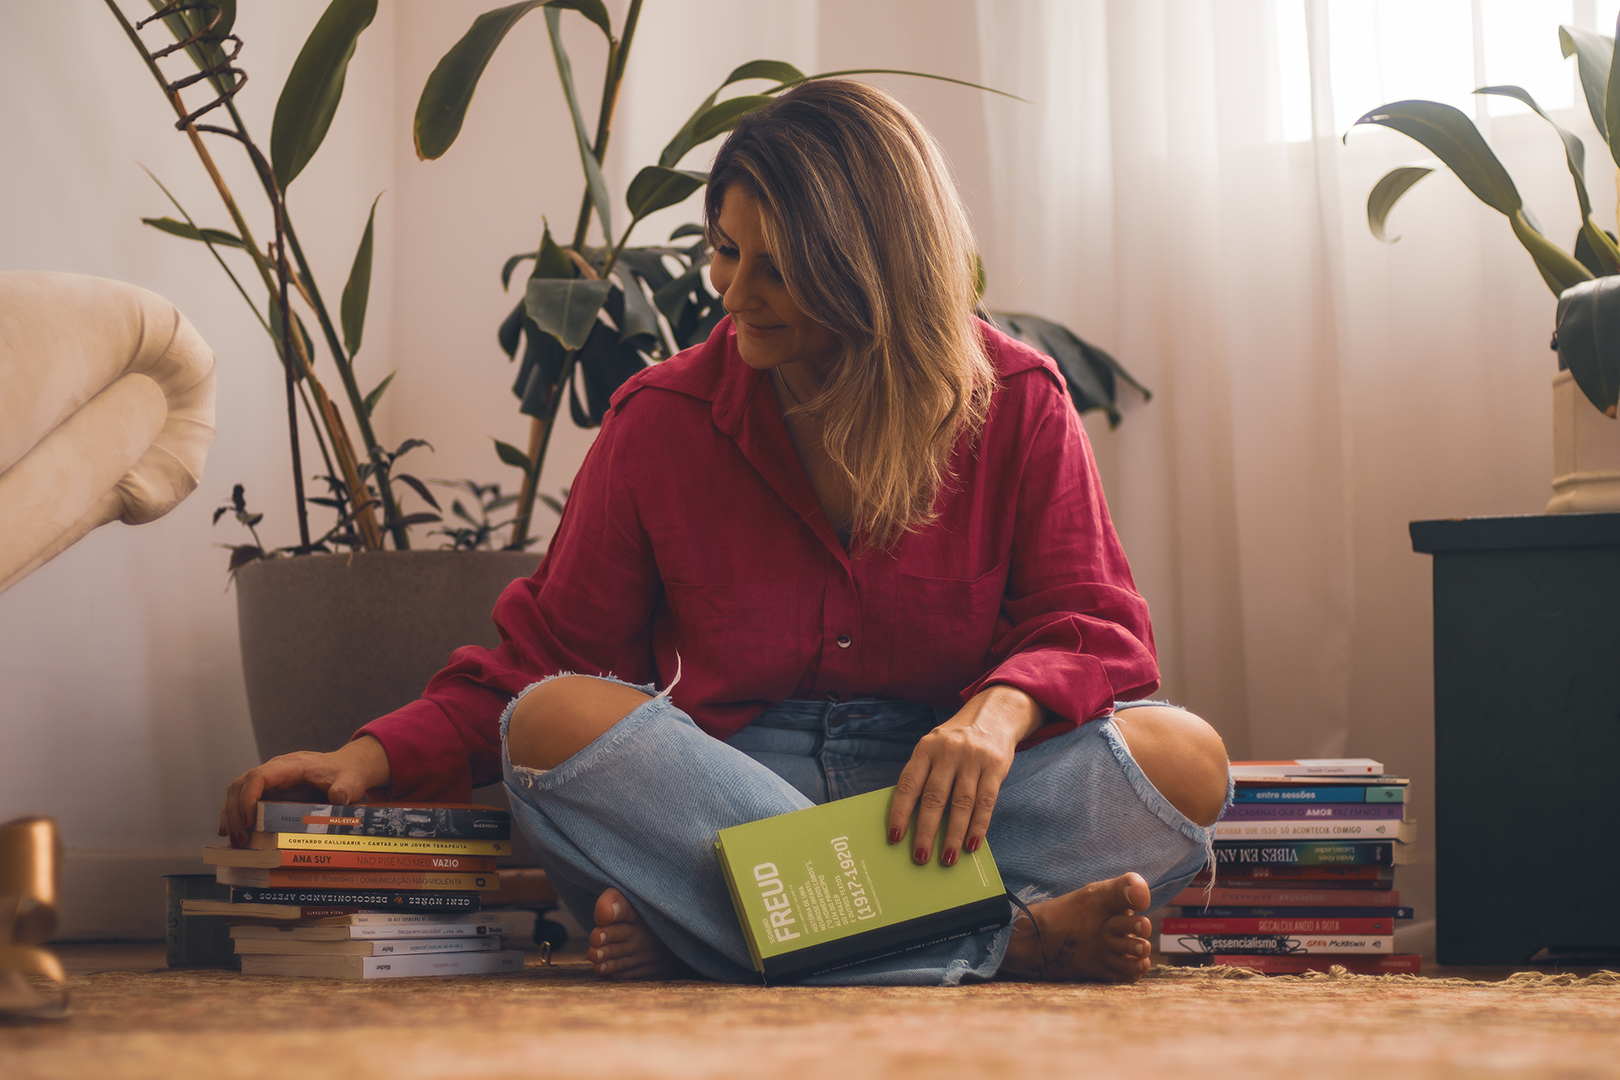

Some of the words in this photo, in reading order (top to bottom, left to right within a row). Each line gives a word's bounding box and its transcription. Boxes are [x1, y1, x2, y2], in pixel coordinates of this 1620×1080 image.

[1282, 790, 1316, 799] sessões
[1306, 808, 1333, 816] AMOR
[1334, 808, 1348, 816] FAZ
[1350, 808, 1362, 816] EM
[1363, 807, 1382, 816] NÓS
[1244, 827, 1258, 835] QUE
[1280, 824, 1290, 834] SÓ
[1292, 826, 1330, 834] ACONTECIA
[1332, 826, 1362, 834] COMIGO
[292, 854, 312, 864] ANA
[314, 855, 332, 864] SUY
[356, 854, 376, 866] NÃO
[379, 857, 395, 866] PISE
[396, 857, 411, 866] NO
[412, 858, 431, 867] MEU
[432, 858, 459, 868] VAZIO
[1240, 848, 1259, 862] EM
[1261, 848, 1298, 862] VIBES
[830, 835, 876, 920] (1917-1920)
[1254, 868, 1270, 877] POR
[288, 874, 313, 882] Marshall
[322, 875, 354, 884] Rosenberg
[360, 876, 412, 886] COMUNICAÇÃO
[413, 877, 463, 886] NÃO-VIOLENTA
[834, 874, 846, 895] TEXTOS
[798, 885, 807, 898] UMA
[804, 880, 817, 903] INFANTIL
[814, 885, 822, 897] DOS
[817, 874, 832, 901] PRINCÍPIO
[260, 892, 296, 900] AFETOS
[300, 894, 388, 904] DESCOLONIZANDO
[408, 897, 442, 906] NÚÑEZ
[446, 898, 470, 906] GENI
[753, 861, 800, 942] FREUD
[802, 898, 810, 906] DE
[818, 897, 830, 918] HOMEM
[828, 902, 835, 910] DO
[833, 893, 845, 915] PRAZER
[842, 895, 854, 917] OUTROS
[804, 907, 819, 933] HISTÓRIA
[812, 904, 826, 930] NEUROSE
[830, 911, 841, 926] ALÉM
[841, 916, 848, 924] DO
[1258, 920, 1314, 932] RECALCULANDO
[1316, 921, 1321, 931] A
[1322, 921, 1340, 930] ROTA
[1212, 937, 1278, 949] essencialismo
